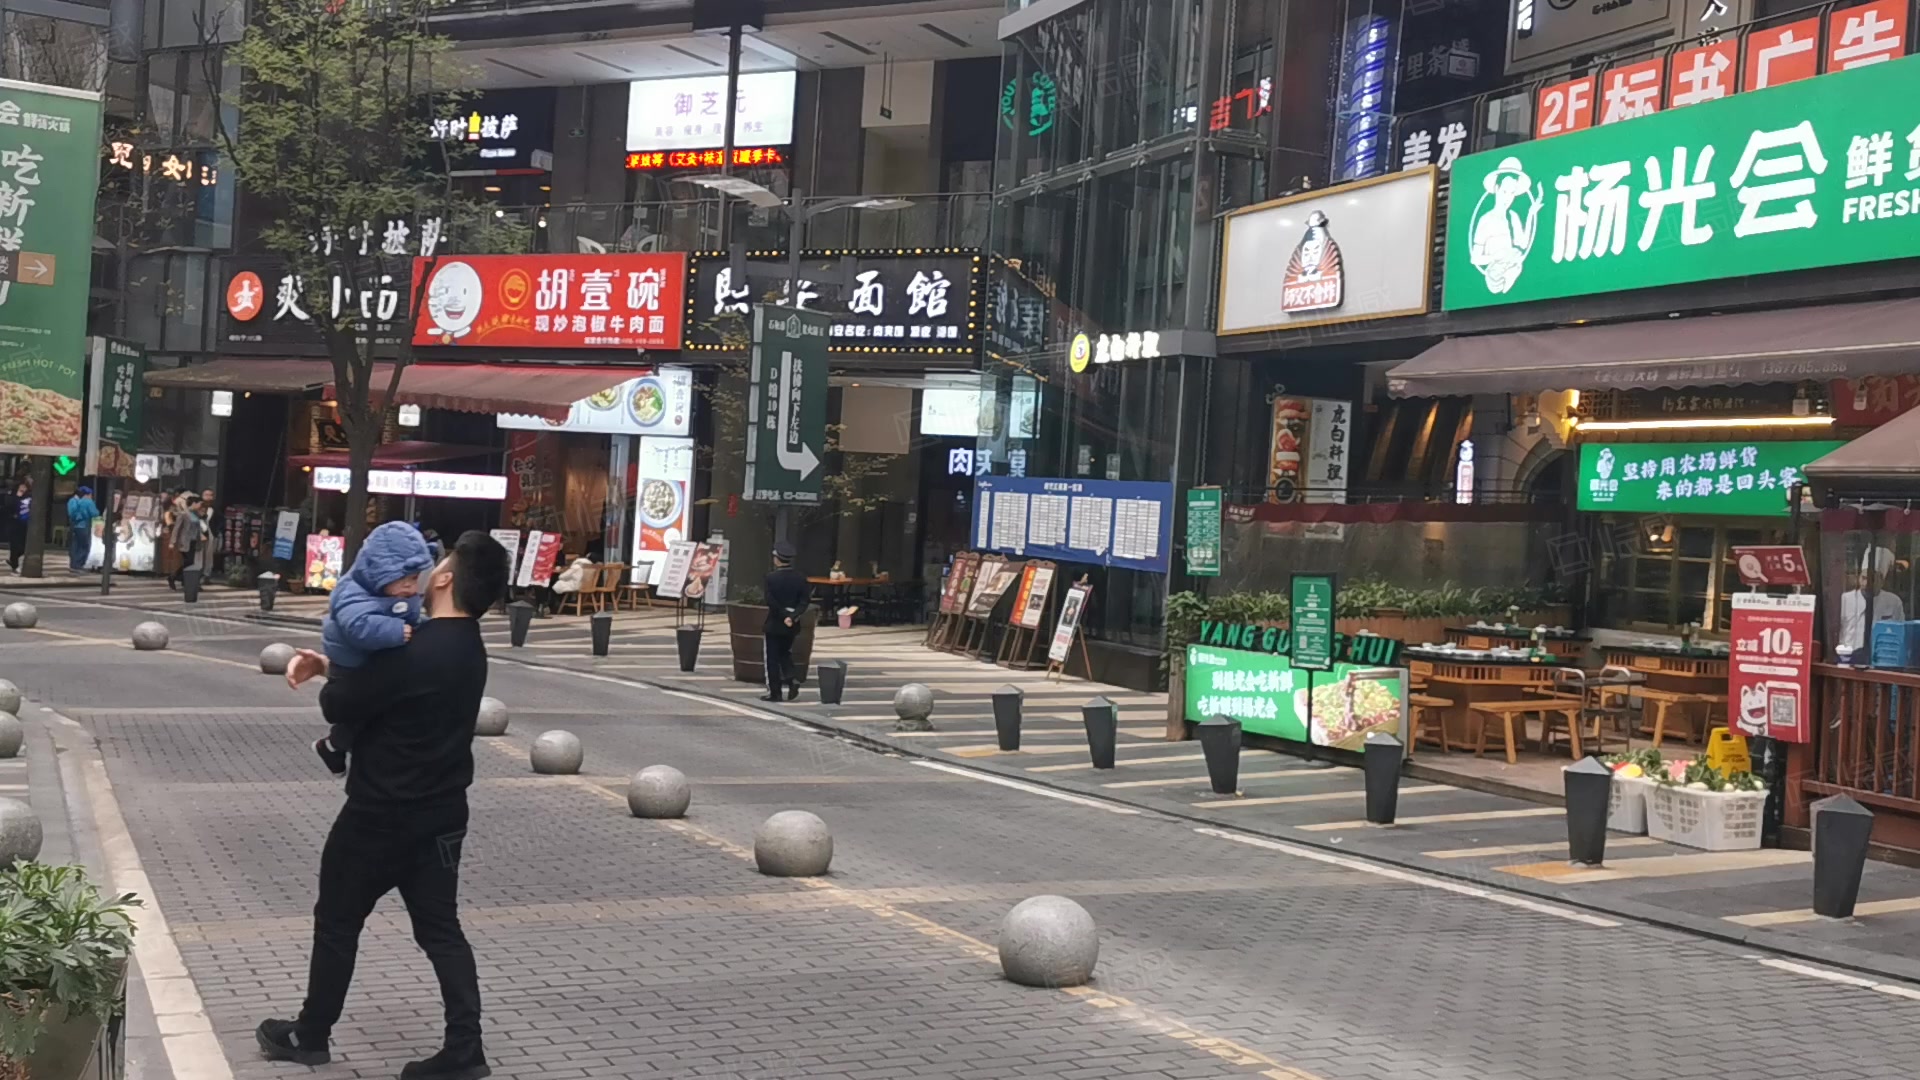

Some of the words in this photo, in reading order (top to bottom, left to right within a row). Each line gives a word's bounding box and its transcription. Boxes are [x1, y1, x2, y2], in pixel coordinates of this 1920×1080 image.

[1538, 82, 1590, 135] 2F
[1402, 122, 1468, 171] 美发
[1550, 118, 1830, 264] 杨光会
[536, 268, 660, 310] 胡壹碗
[534, 314, 664, 334] 现炒泡椒牛肉面
[1621, 445, 1759, 482] 坚持用农场鲜货
[1656, 466, 1802, 502] 来的都是回头客
[1199, 619, 1258, 650] YANG
[1350, 635, 1398, 666] HUI
